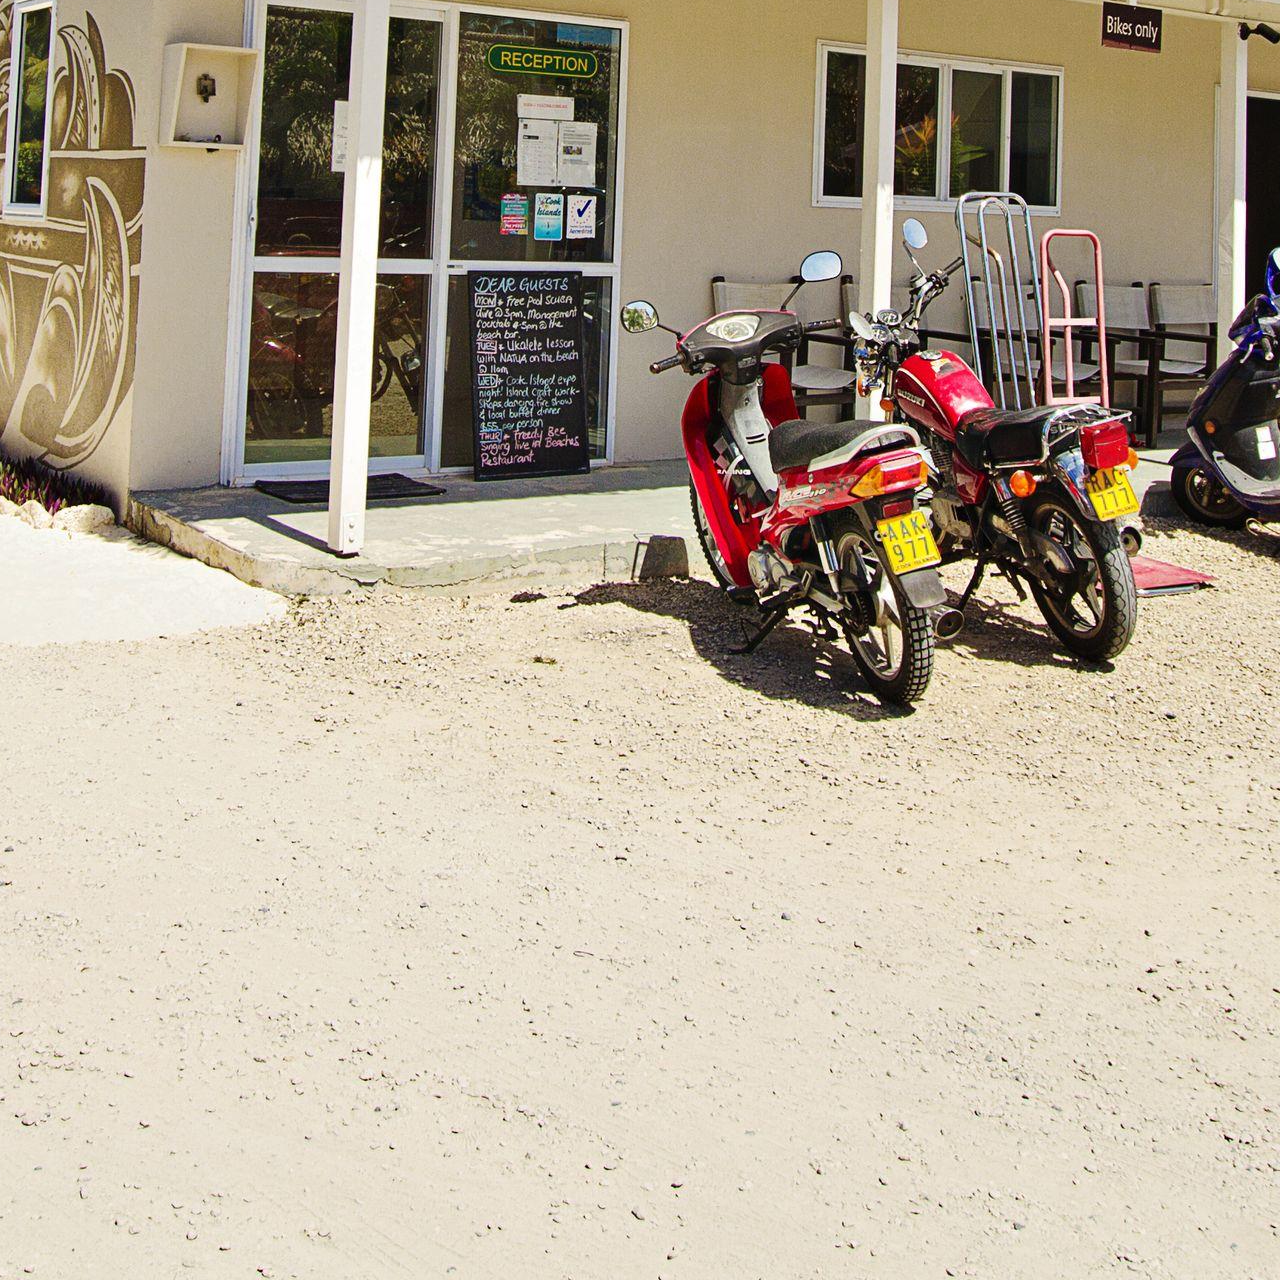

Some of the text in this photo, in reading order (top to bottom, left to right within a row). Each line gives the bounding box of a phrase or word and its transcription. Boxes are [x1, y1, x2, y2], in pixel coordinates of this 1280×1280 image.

[1107, 16, 1158, 43] Bikes only
[501, 51, 588, 72] RECEPTION
[537, 207, 561, 216] Islands
[475, 276, 568, 293] DEAR GUESTS
[546, 338, 574, 348] lesson
[556, 350, 579, 362] beach
[481, 450, 535, 467] Restaurant.
[1096, 488, 1130, 510] 777
[887, 516, 923, 541] AAK
[893, 536, 929, 562] 977
